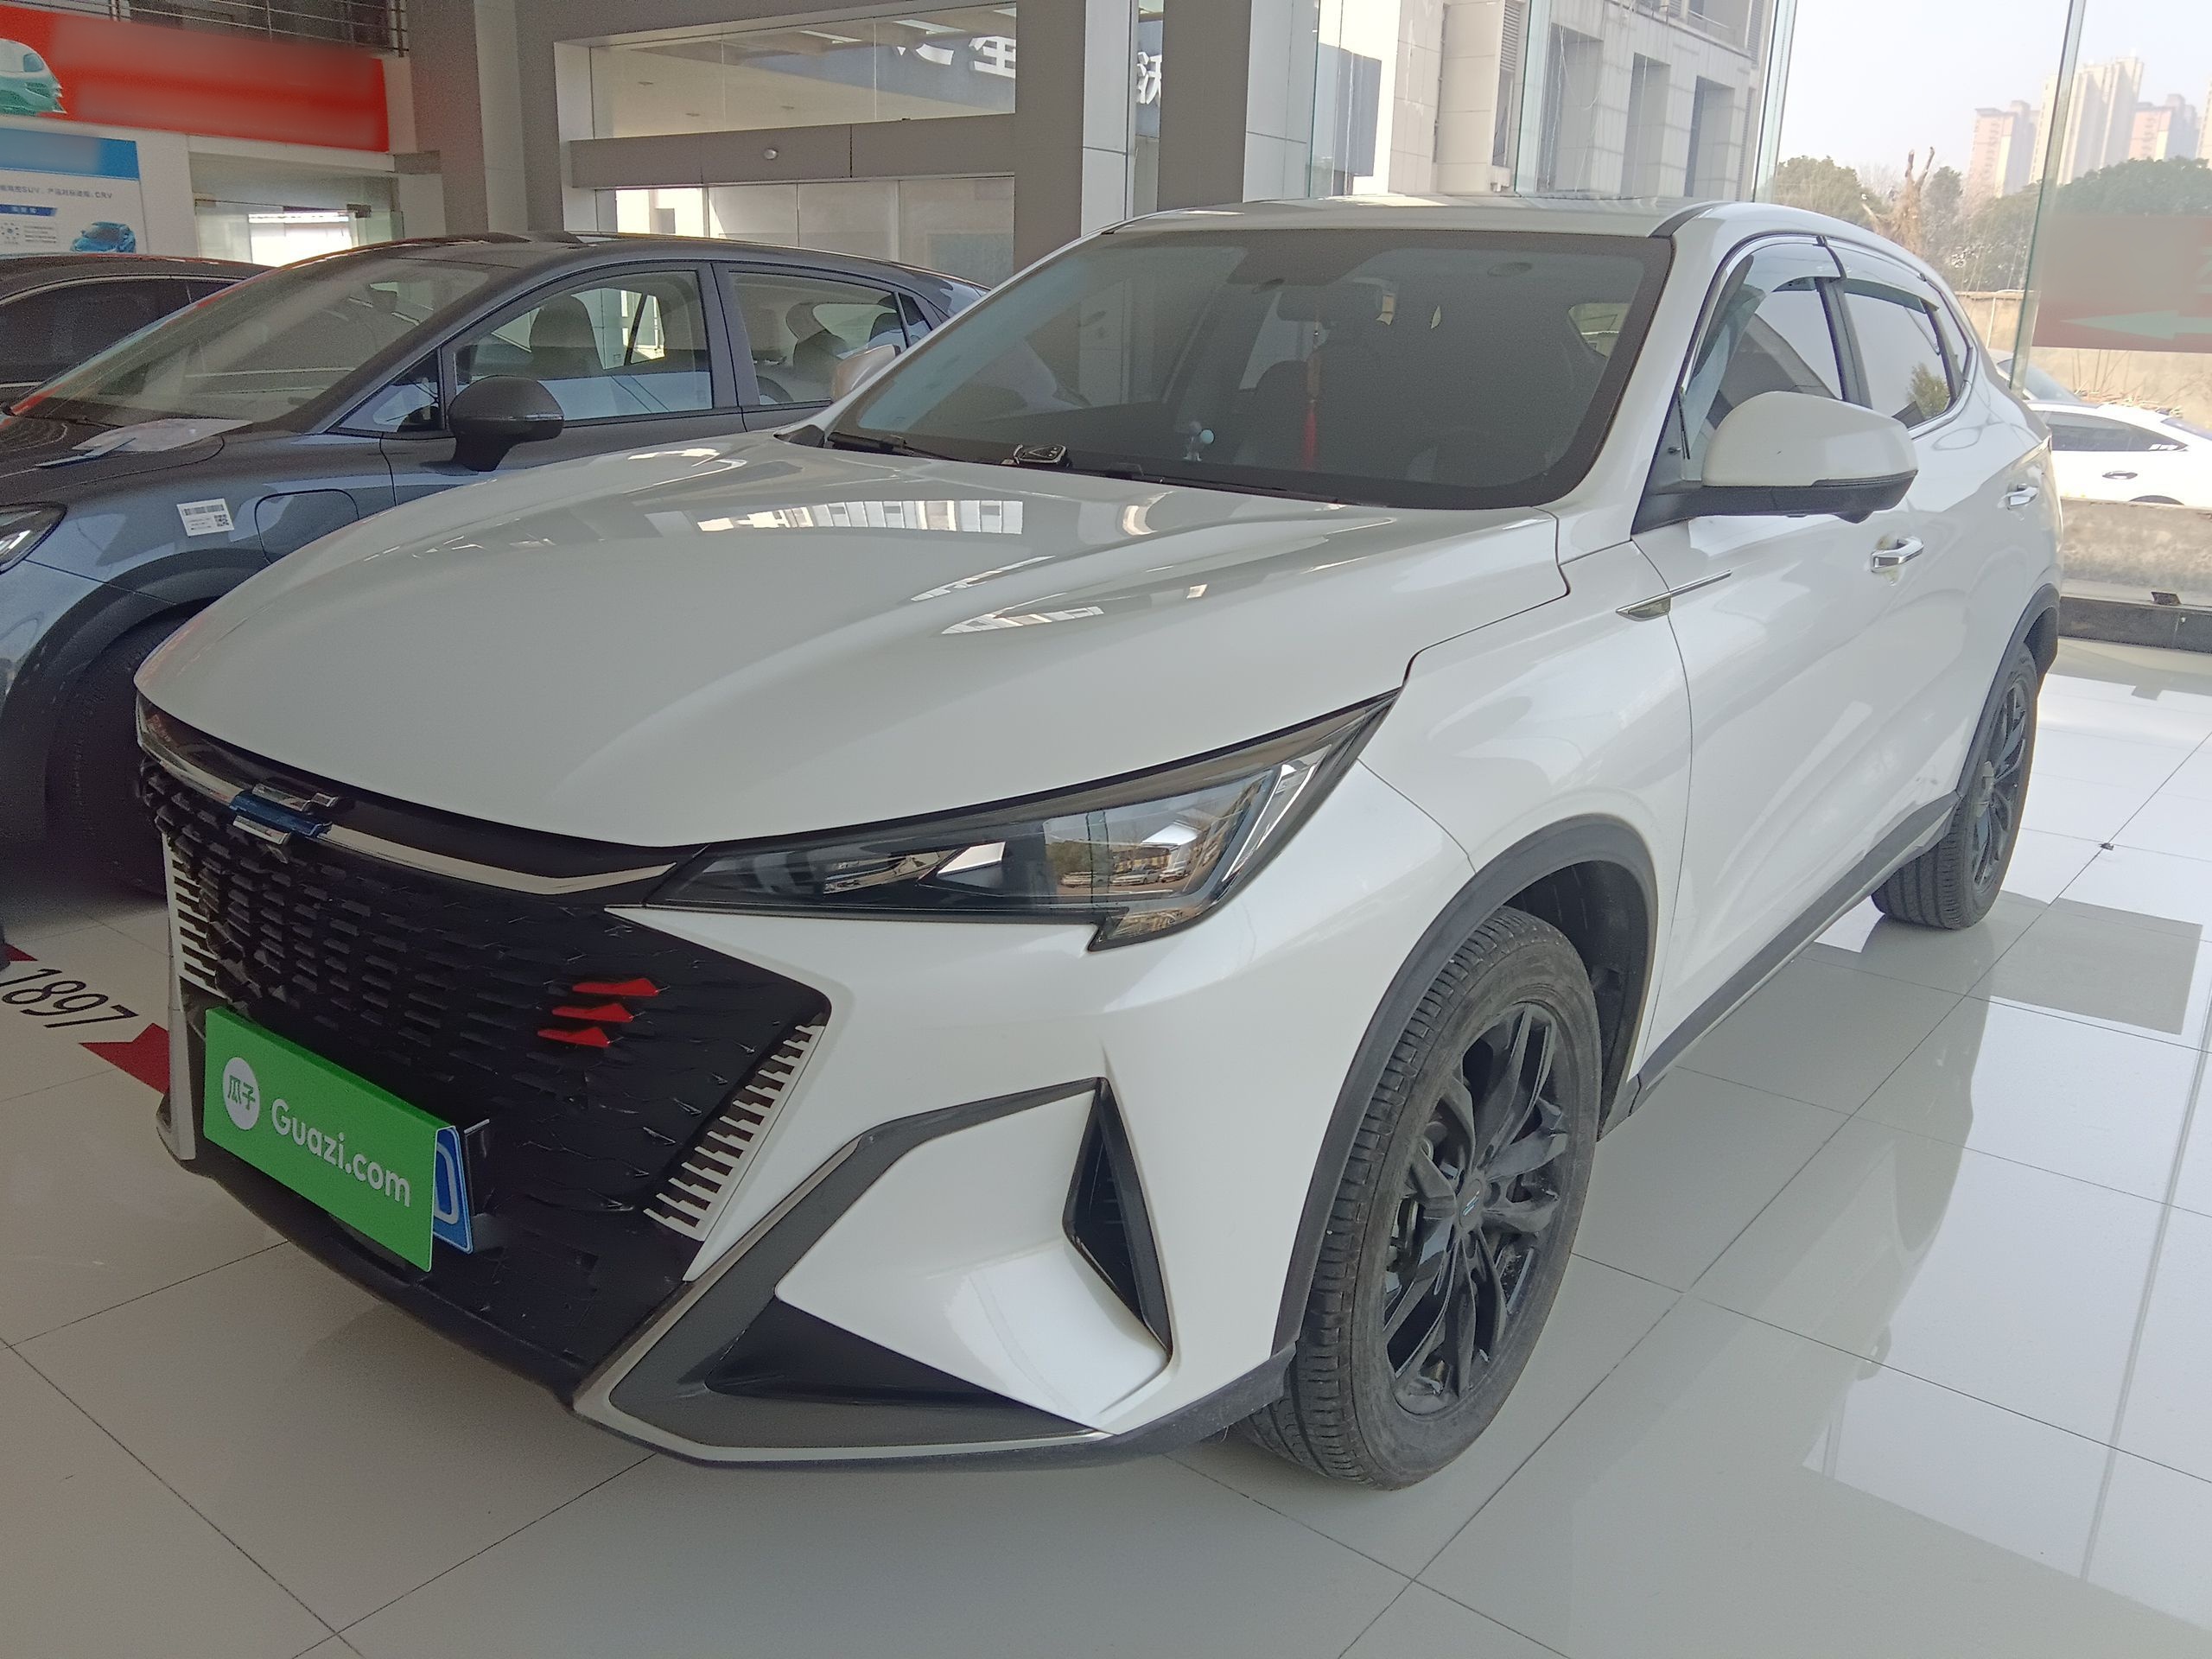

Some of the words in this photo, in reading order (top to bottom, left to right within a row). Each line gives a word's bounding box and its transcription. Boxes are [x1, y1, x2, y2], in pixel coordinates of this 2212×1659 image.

[0, 968, 139, 1028] 1897
[227, 1074, 257, 1111] 瓜子
[270, 1097, 410, 1208] Guazi.com
